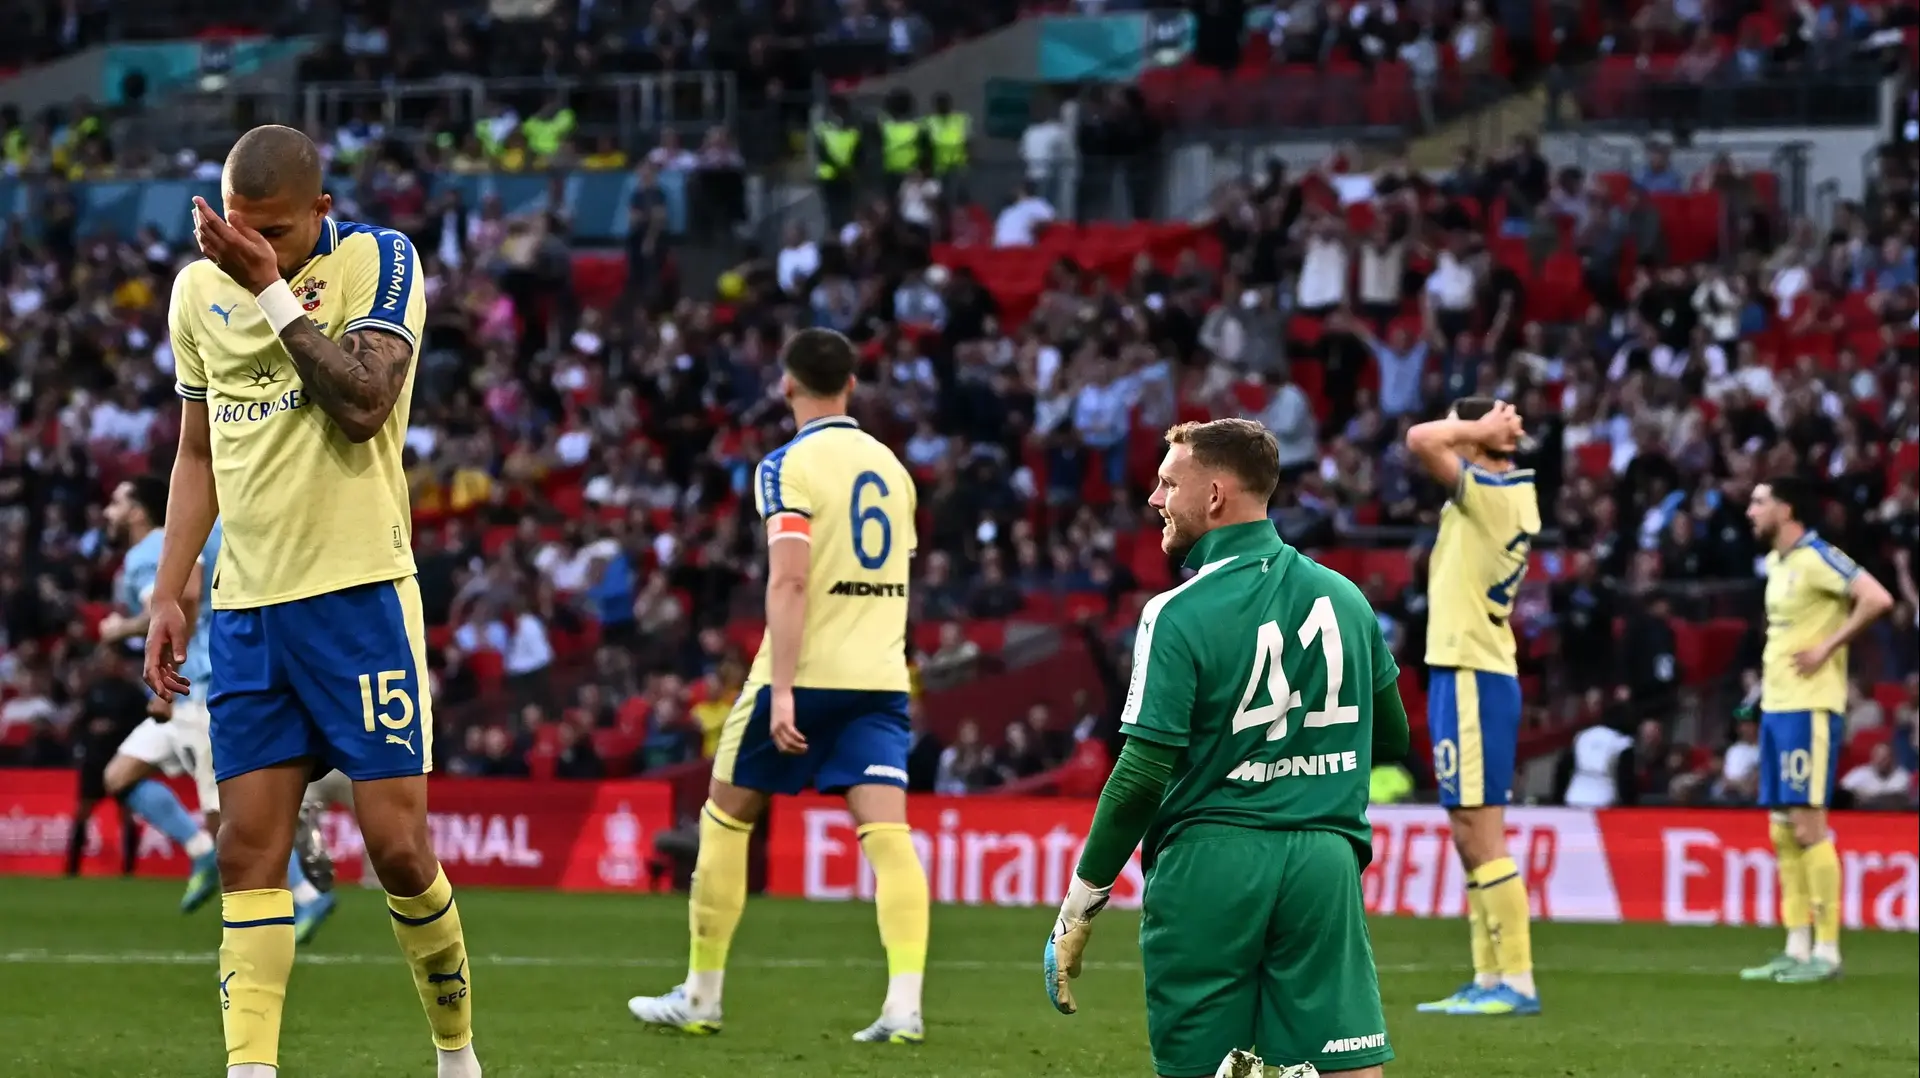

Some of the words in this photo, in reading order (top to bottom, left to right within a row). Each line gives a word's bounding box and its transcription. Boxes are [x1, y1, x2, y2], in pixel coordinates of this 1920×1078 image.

[382, 238, 406, 311] GARMIN
[214, 403, 245, 423] P&O
[850, 470, 892, 570] 6
[828, 580, 910, 597] MIDNITE
[1232, 596, 1359, 741] 41
[358, 669, 414, 732] 15
[1226, 750, 1357, 783] MIDNITE
[1781, 748, 1810, 781] 10
[803, 808, 1145, 908] Eirats
[1662, 827, 1919, 930] Emra
[437, 987, 467, 1006] SFC
